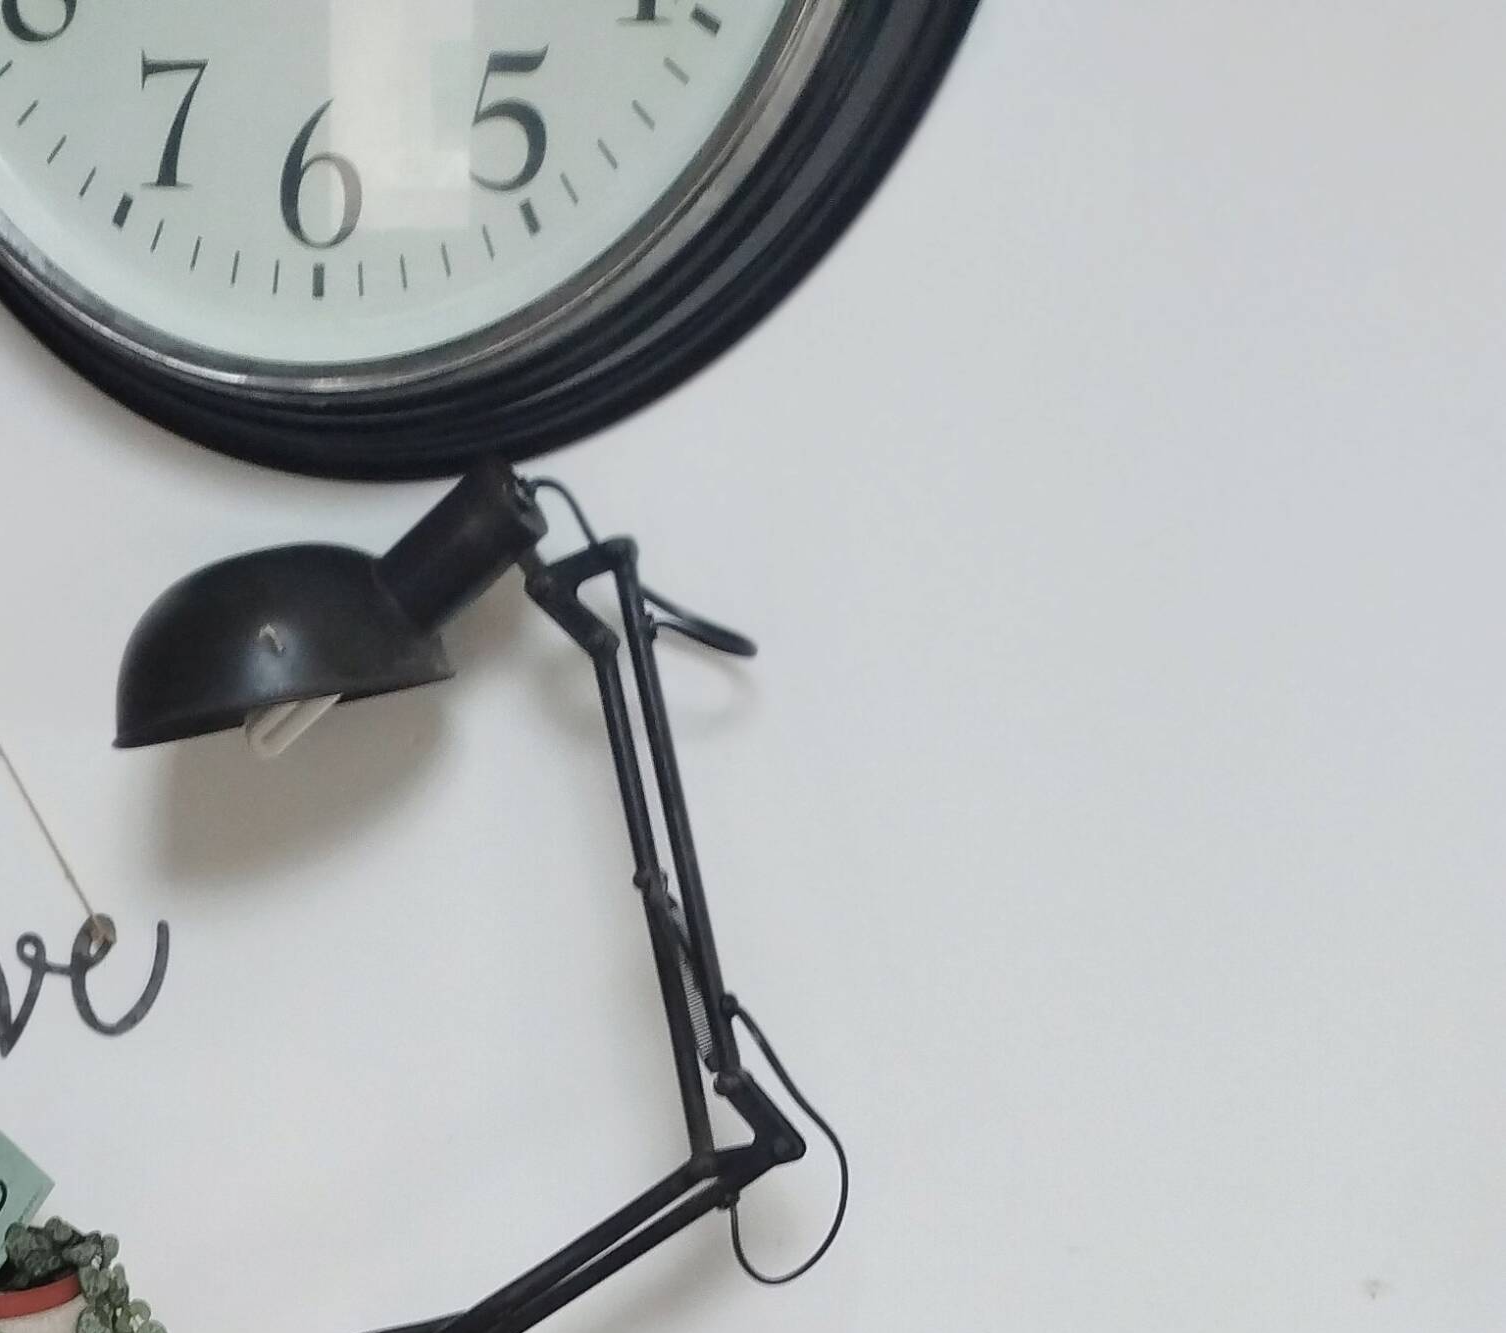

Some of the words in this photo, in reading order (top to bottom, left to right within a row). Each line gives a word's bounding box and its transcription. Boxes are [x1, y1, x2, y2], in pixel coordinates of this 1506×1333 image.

[141, 49, 209, 190] 7
[280, 98, 362, 249] 6
[468, 44, 549, 193] 5
